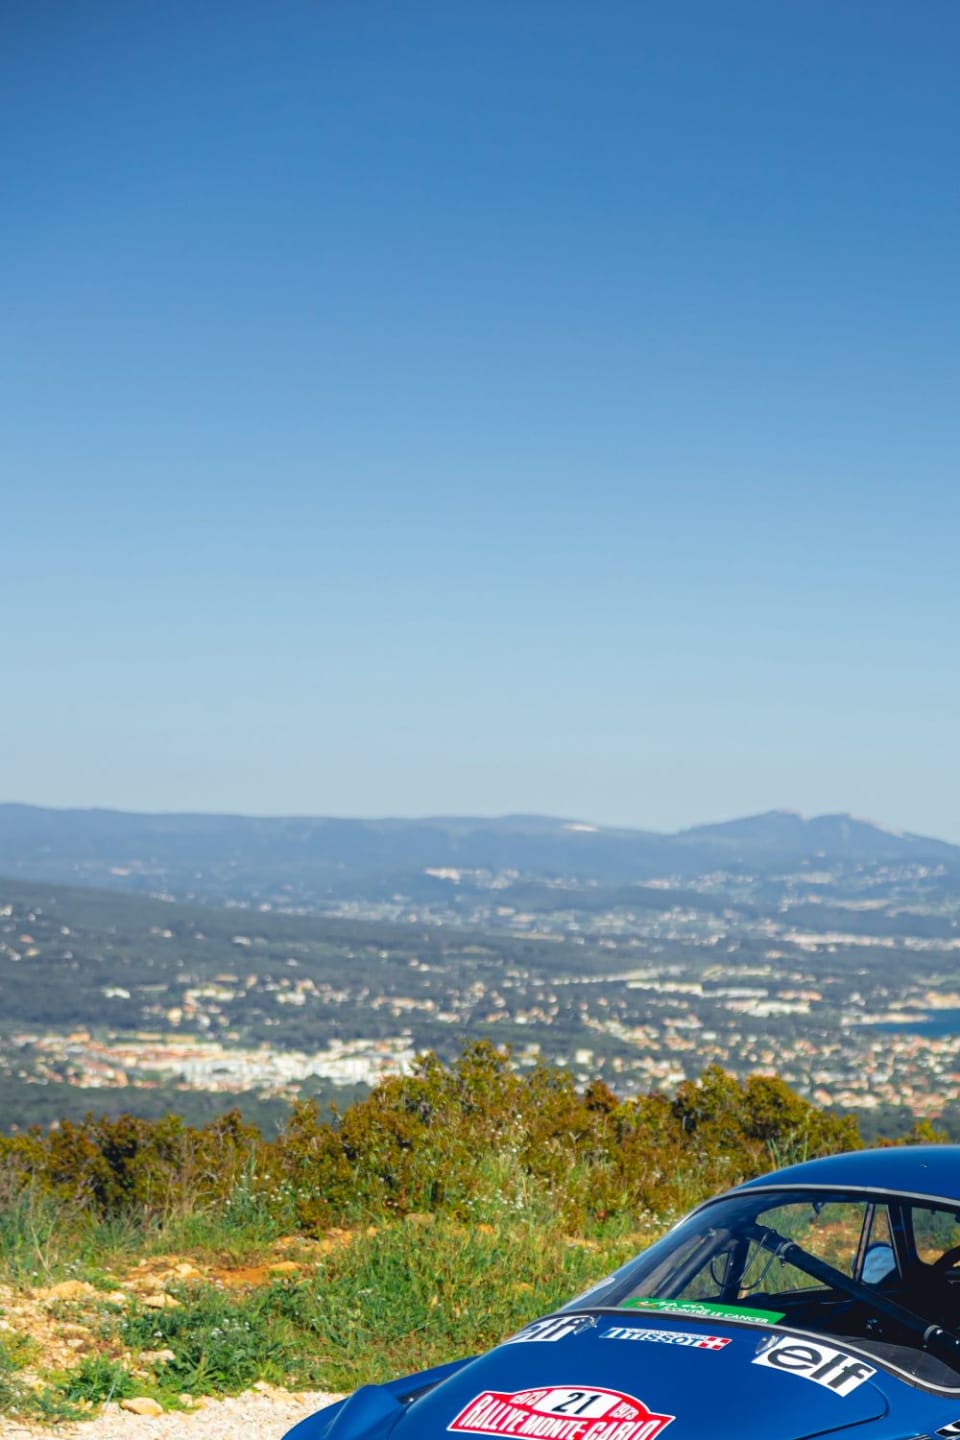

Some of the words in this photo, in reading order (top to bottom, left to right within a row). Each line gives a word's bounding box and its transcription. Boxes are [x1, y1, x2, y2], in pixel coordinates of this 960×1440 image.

[626, 1331, 703, 1346] TISSOT
[767, 1345, 874, 1389] elf
[458, 1395, 529, 1433] RALLYE
[551, 1392, 602, 1414] 21
